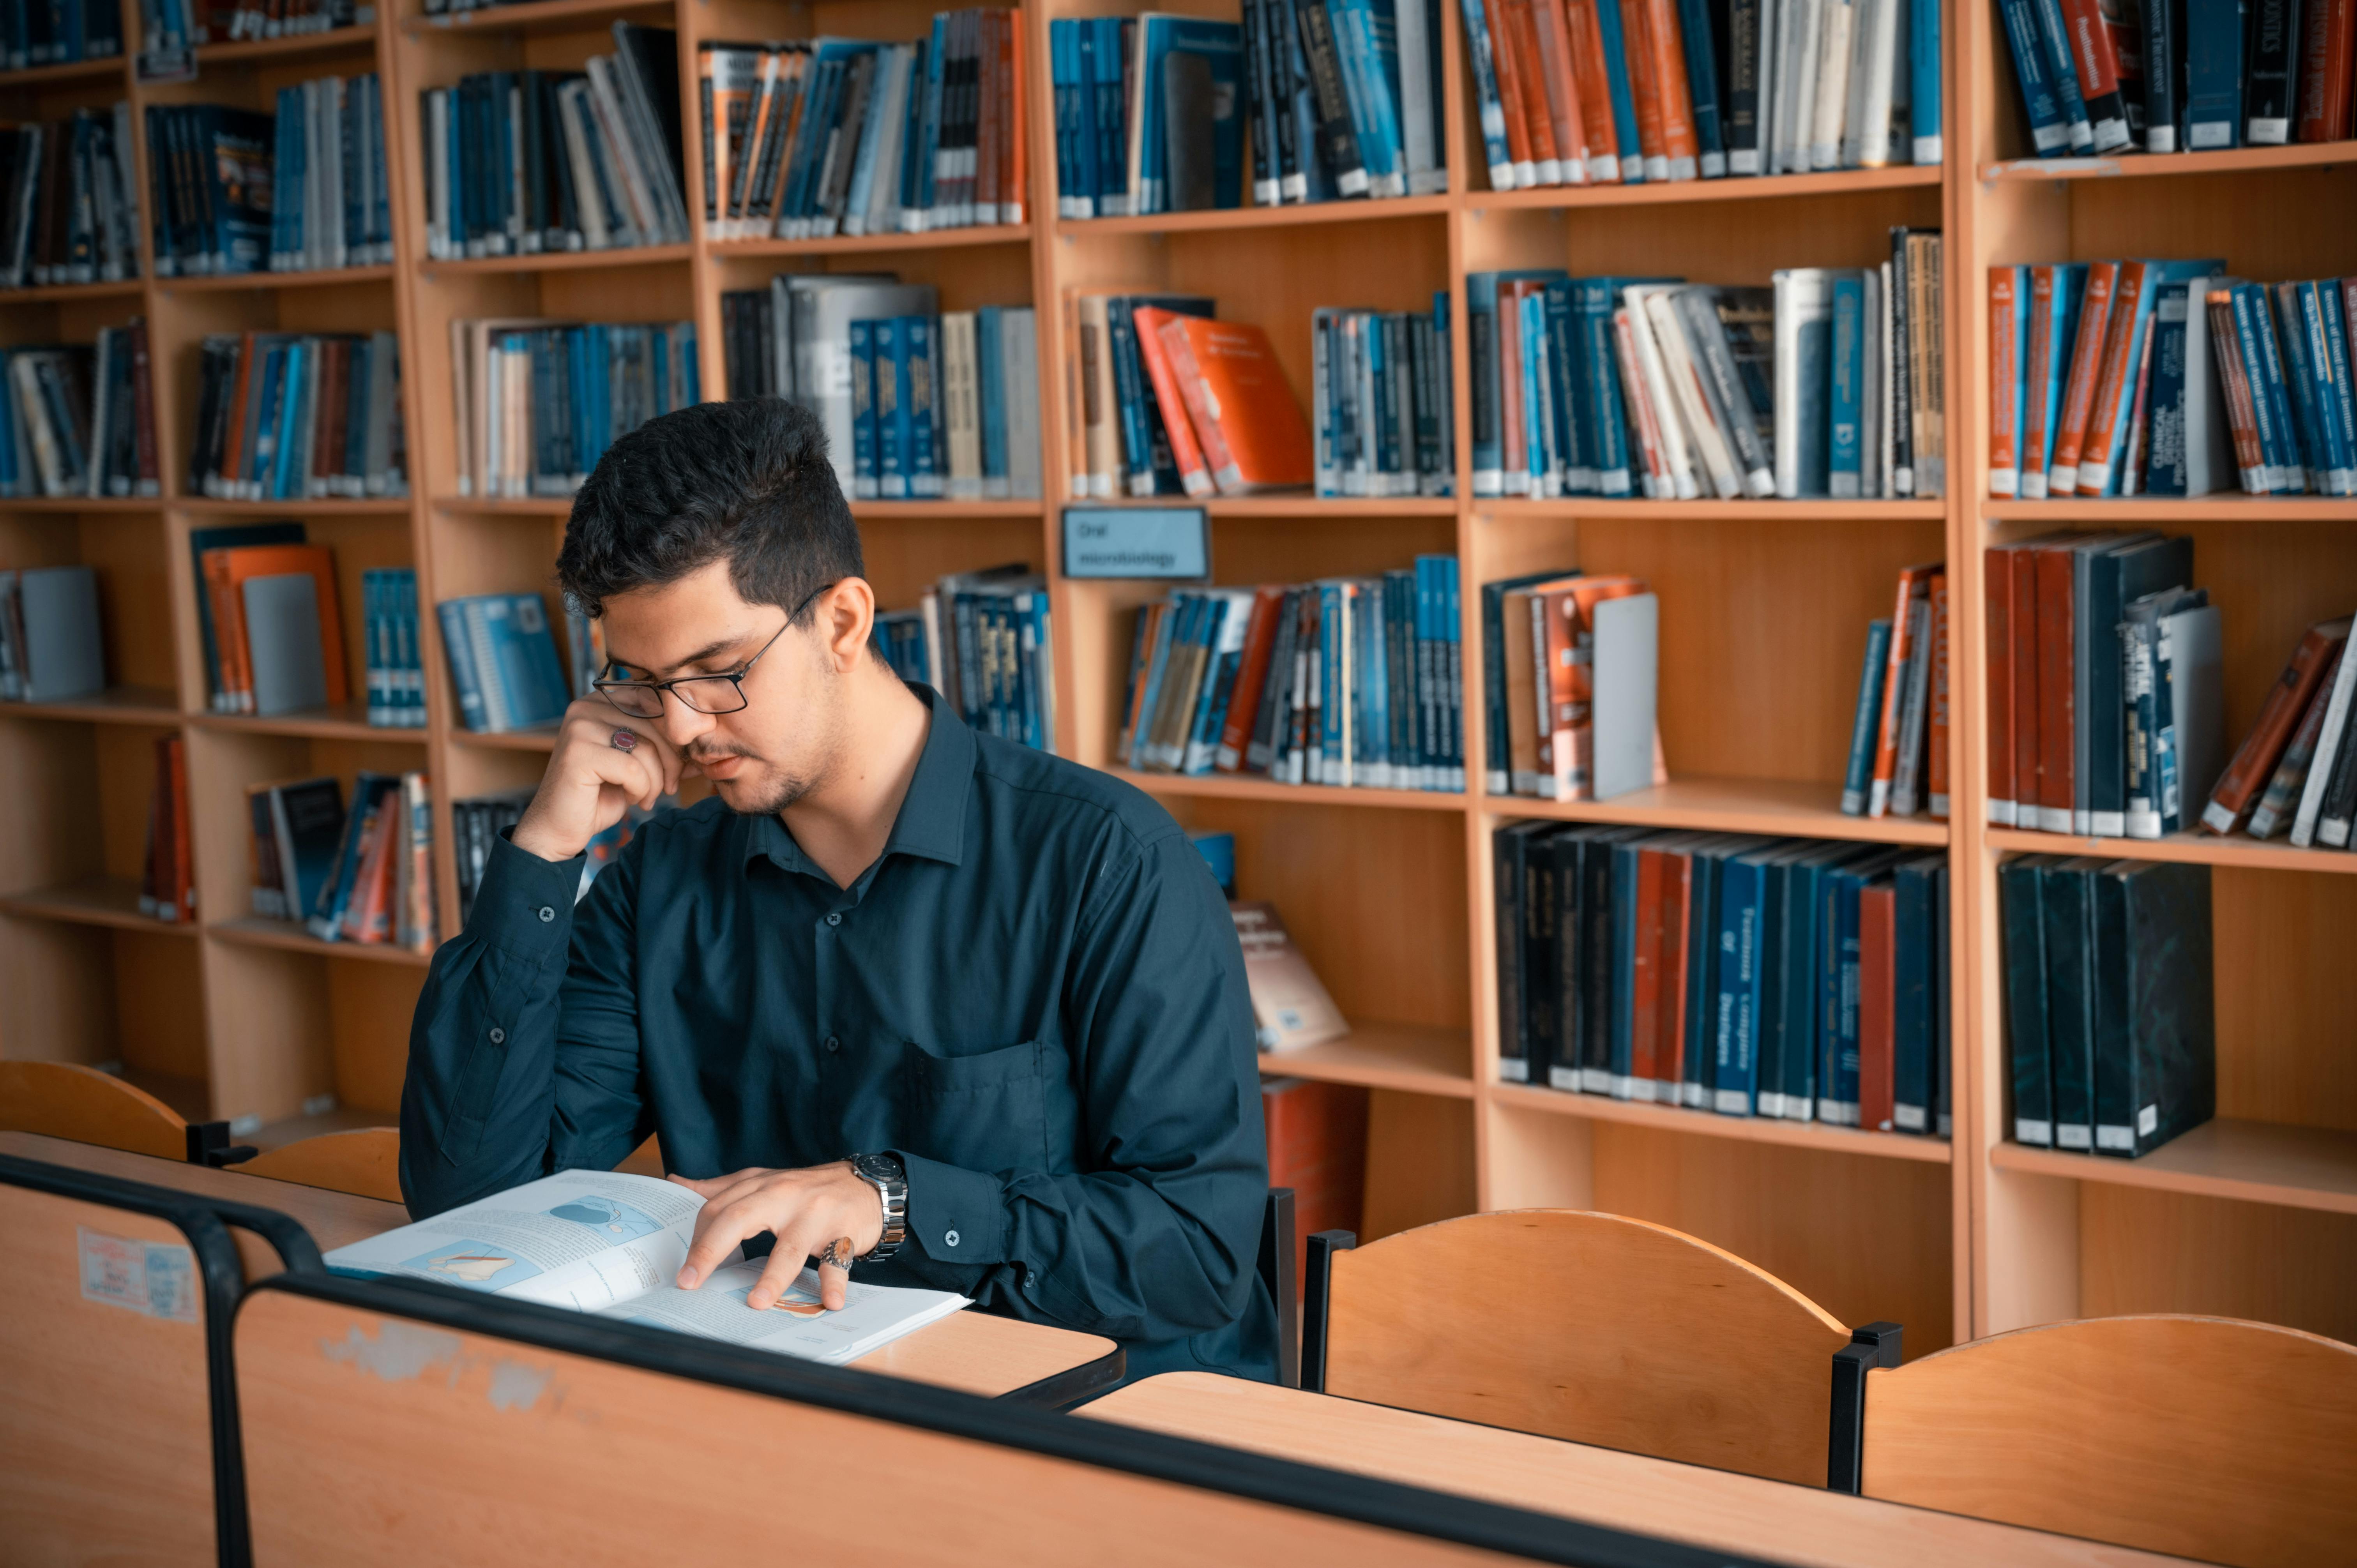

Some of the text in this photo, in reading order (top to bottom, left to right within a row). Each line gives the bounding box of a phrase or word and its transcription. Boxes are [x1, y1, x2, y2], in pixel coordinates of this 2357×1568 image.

[2077, 16, 2100, 90] Prosthodontics
[2235, 292, 2272, 441] Review of Fixed Partial Dentures
[2262, 326, 2279, 384] Prosthodontics
[2309, 321, 2326, 381] Prosthodontics
[2323, 290, 2355, 442] Review of Fixed Partial Dentures
[2152, 404, 2166, 469] CLINICAL
[1078, 523, 1106, 537] Oral
[1080, 552, 1175, 567] microbiology
[603, 1282, 615, 1301] Clinical
